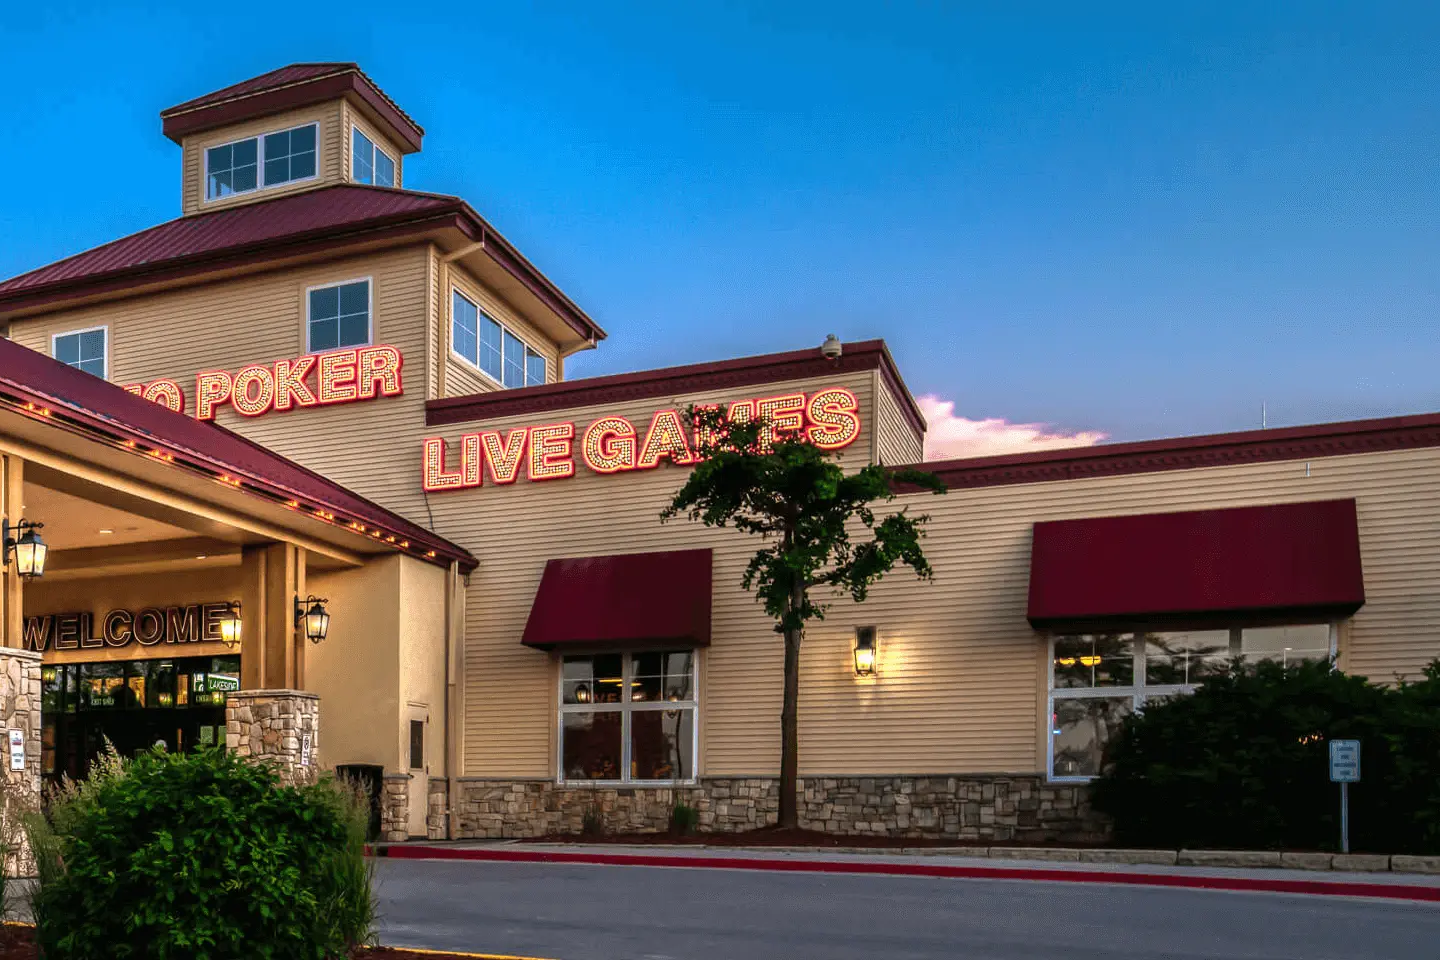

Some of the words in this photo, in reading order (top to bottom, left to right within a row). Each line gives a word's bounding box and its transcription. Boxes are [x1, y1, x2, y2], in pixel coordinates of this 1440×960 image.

[196, 344, 404, 421] POKER
[422, 422, 574, 492] LIVE
[23, 603, 230, 651] WELCOME
